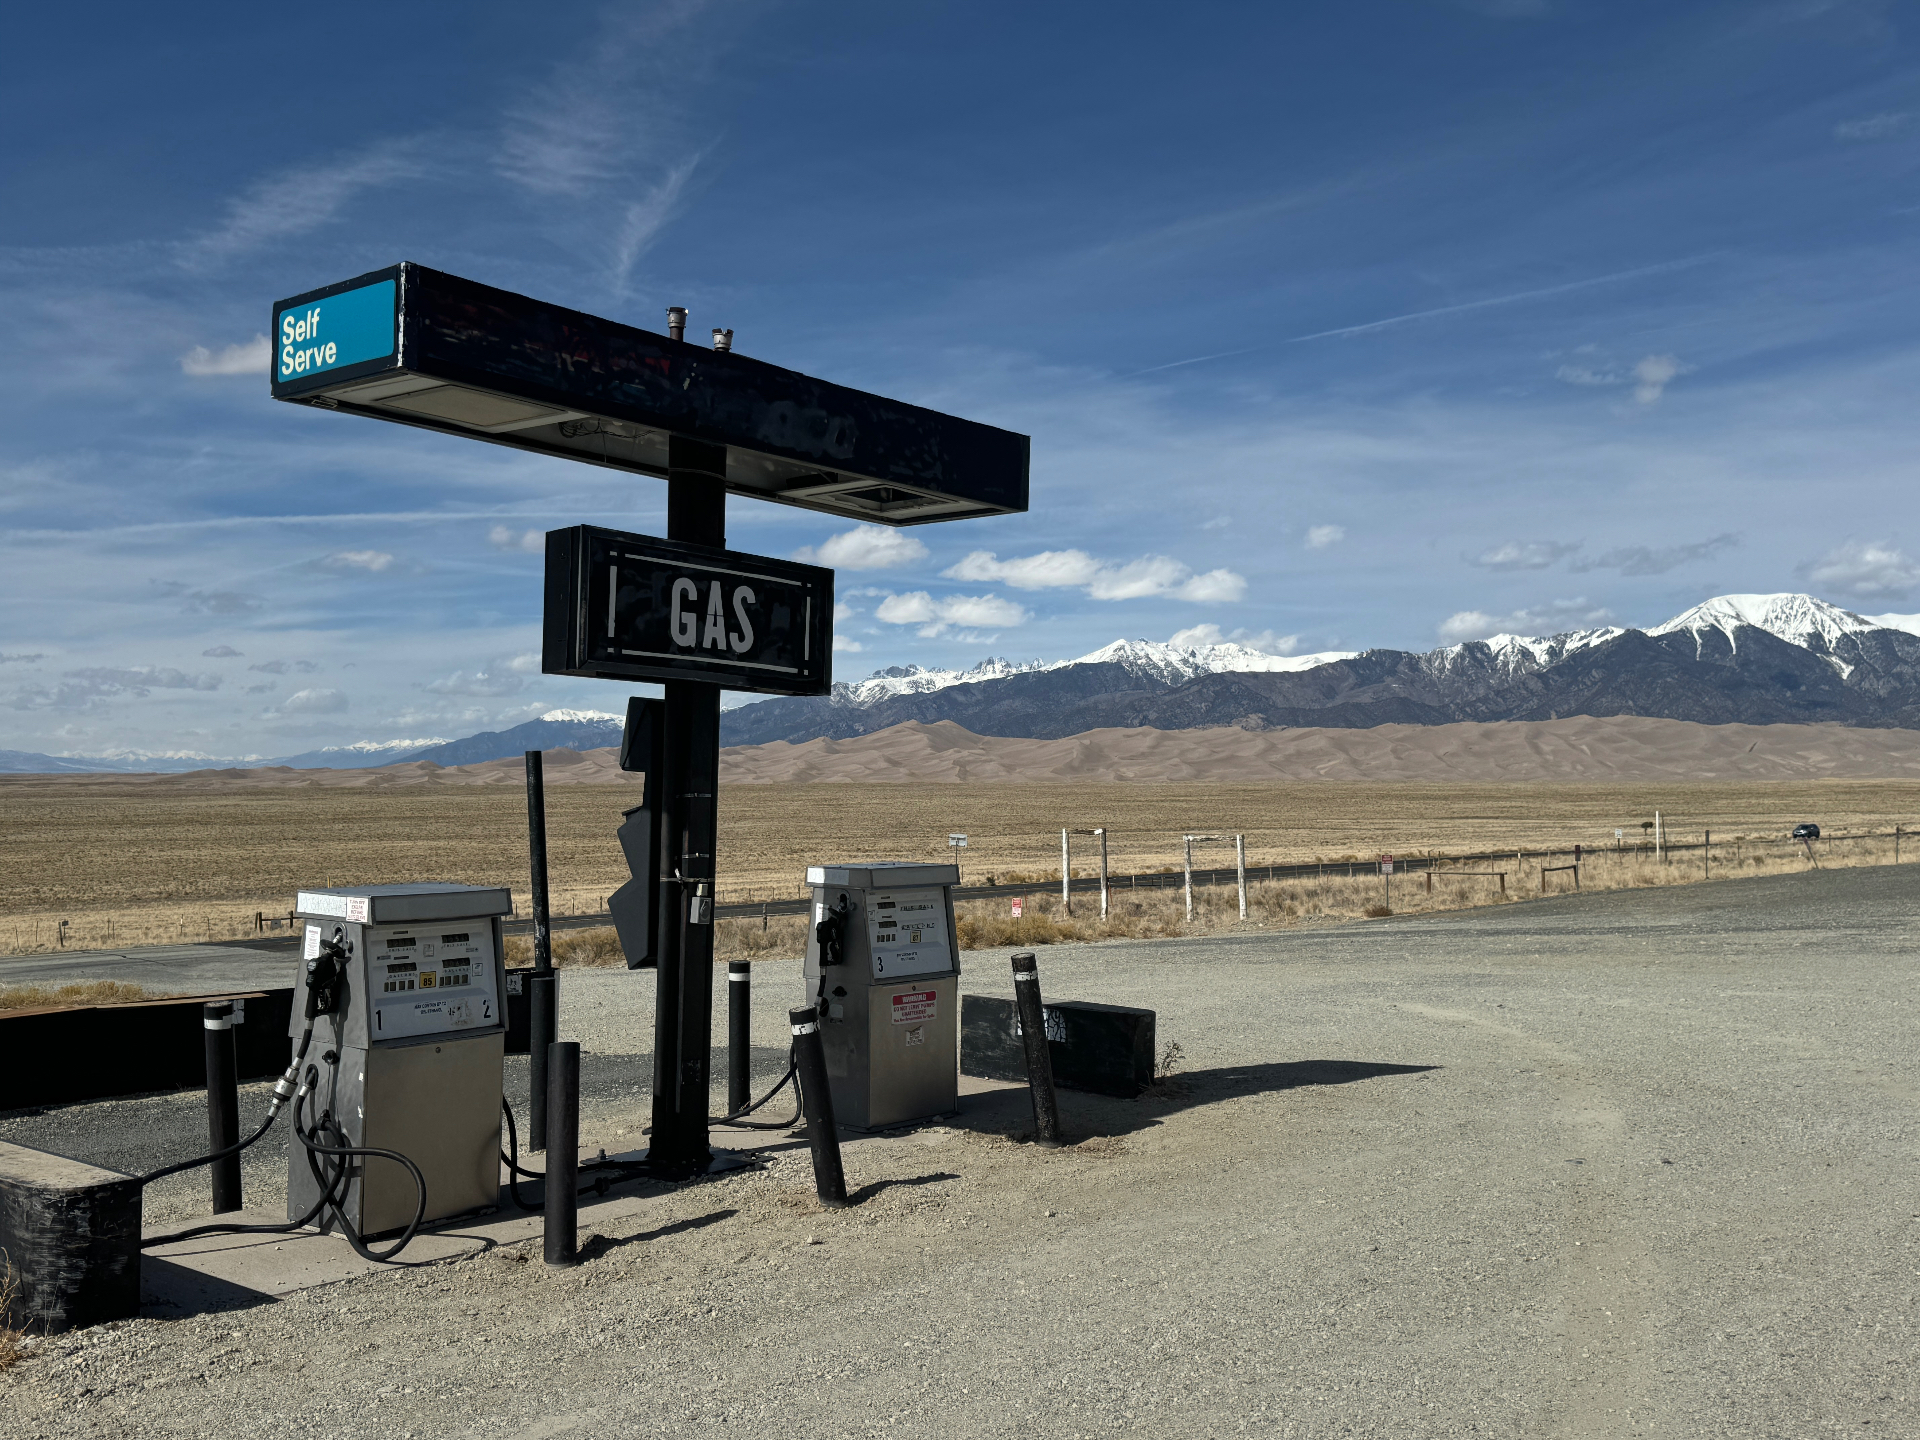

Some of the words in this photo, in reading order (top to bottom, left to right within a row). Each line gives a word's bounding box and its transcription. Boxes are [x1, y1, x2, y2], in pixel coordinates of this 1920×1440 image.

[282, 307, 321, 345] Self
[281, 341, 337, 375] Serve
[670, 577, 756, 654] GAS
[877, 956, 883, 973] 3
[423, 977, 432, 987] 85
[902, 993, 927, 1003] WARNING
[483, 999, 491, 1018] 2
[375, 1009, 382, 1031] 1
